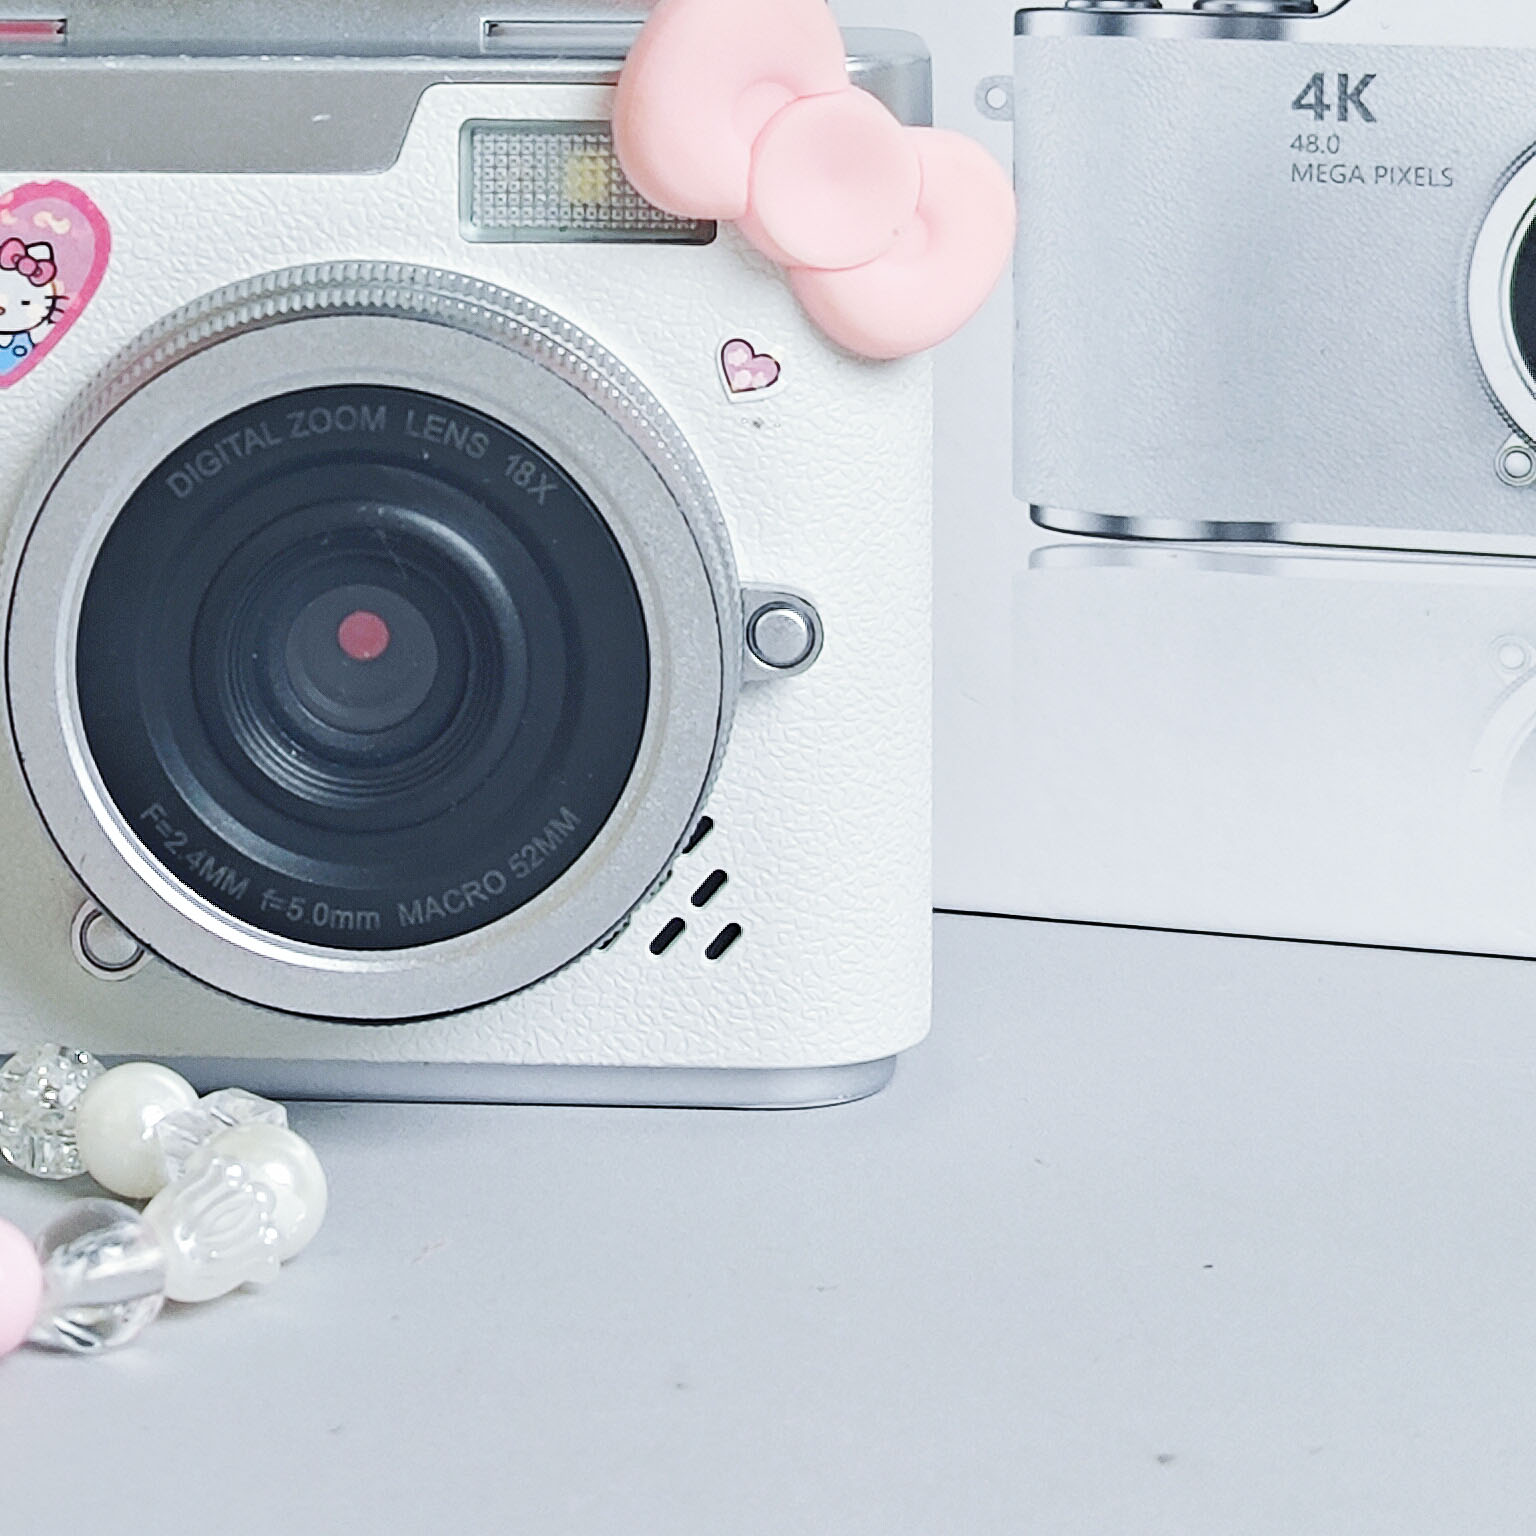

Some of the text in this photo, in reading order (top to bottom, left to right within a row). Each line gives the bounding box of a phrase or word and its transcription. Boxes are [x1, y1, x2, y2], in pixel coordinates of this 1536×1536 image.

[1291, 72, 1377, 123] 4K
[1290, 133, 1340, 154] 48.0
[1291, 164, 1454, 187] MEGA PIXELS
[165, 404, 560, 506] DIGITAL ZOOM LENS 18X
[397, 869, 508, 929] MACRO
[509, 805, 583, 889] 52MM
